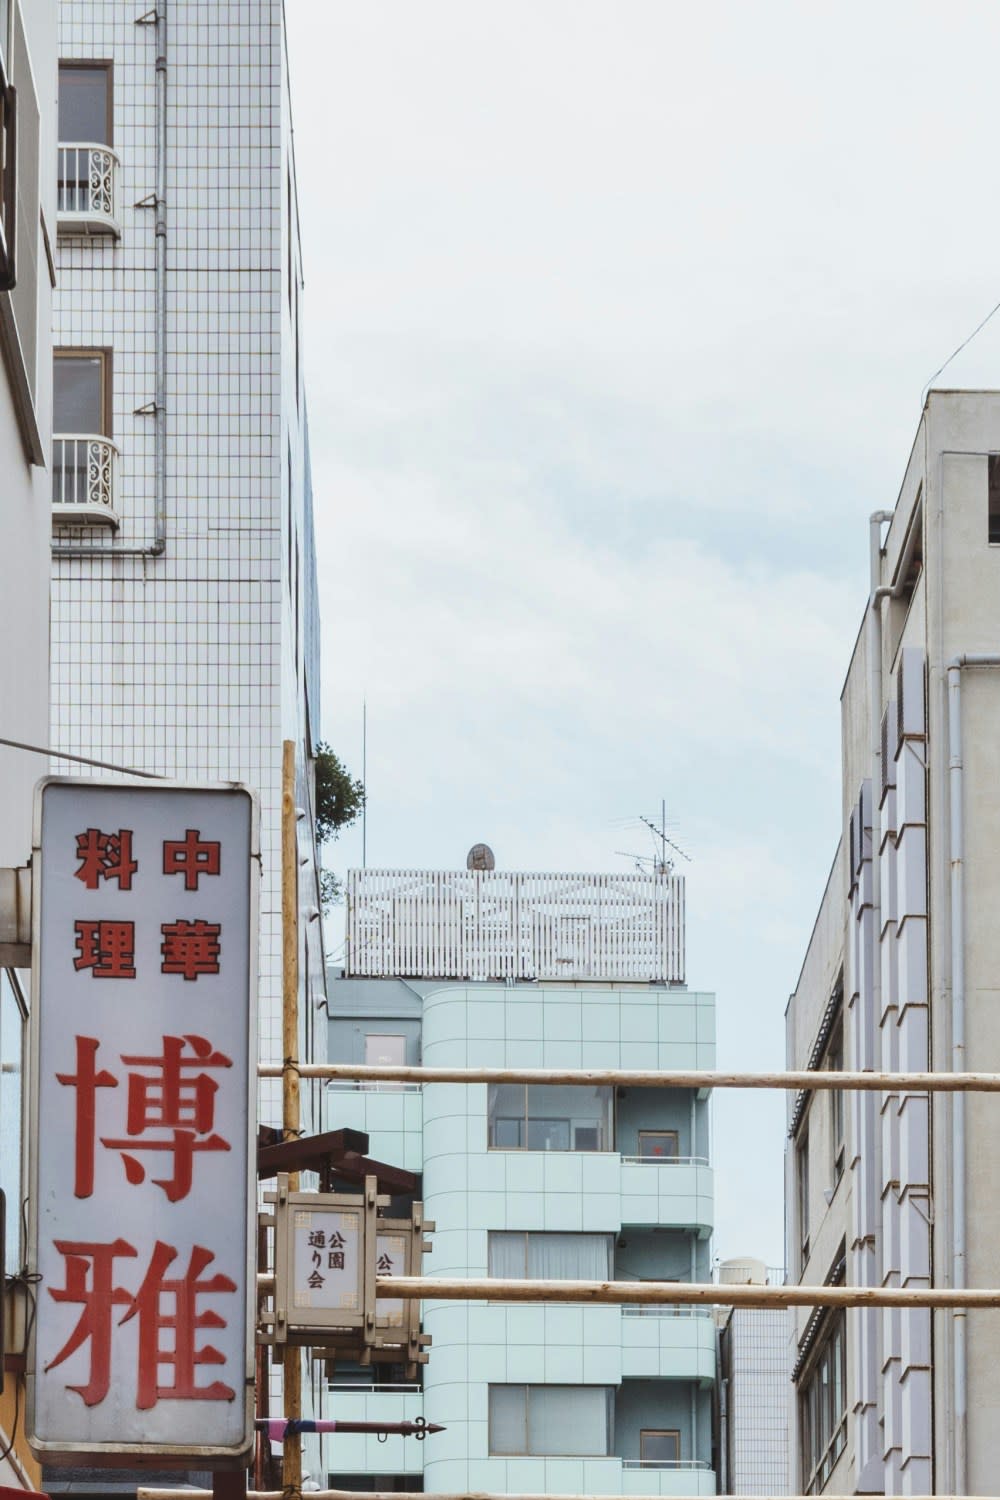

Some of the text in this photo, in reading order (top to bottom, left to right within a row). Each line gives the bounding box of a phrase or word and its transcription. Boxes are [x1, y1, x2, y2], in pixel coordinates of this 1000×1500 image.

[73, 828, 139, 980] 料理
[161, 828, 222, 981] 中華
[43, 1034, 238, 1412] 博雅
[307, 1230, 327, 1289] 通り会
[328, 1231, 347, 1270] 公園
